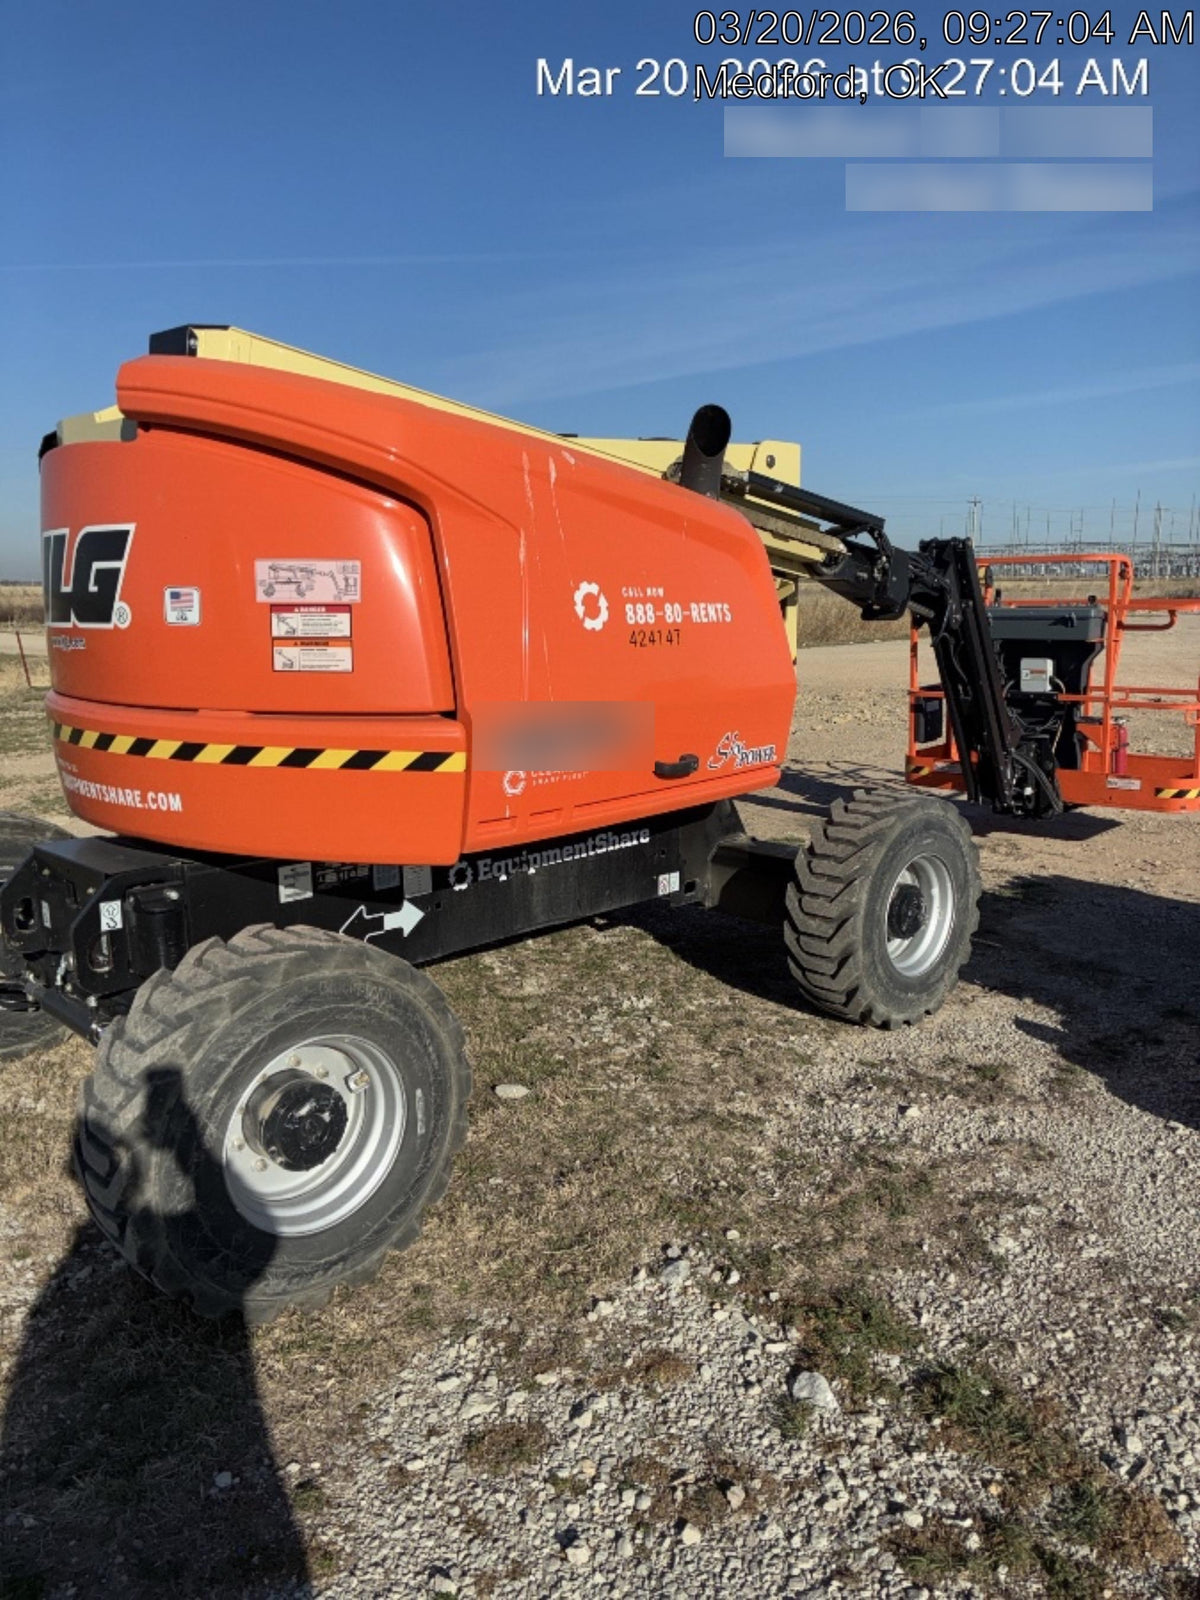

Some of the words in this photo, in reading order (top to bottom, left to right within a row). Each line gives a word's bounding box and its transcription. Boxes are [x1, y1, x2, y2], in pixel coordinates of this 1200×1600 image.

[624, 602, 733, 625] 888-80-RENTS
[628, 628, 682, 648] 424147
[477, 828, 651, 882] EquipmentShare
